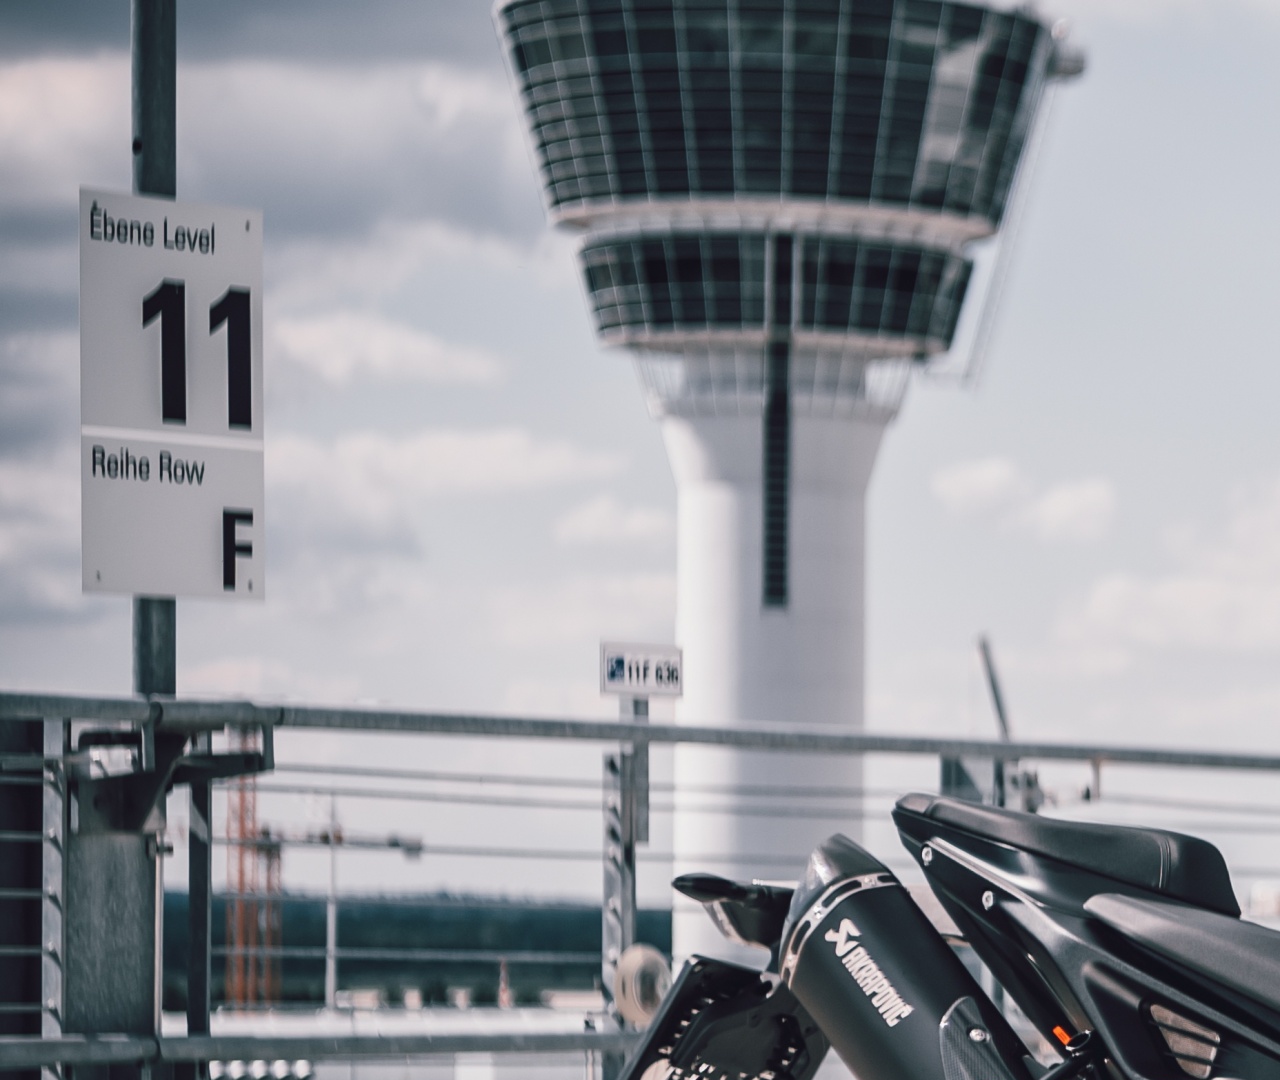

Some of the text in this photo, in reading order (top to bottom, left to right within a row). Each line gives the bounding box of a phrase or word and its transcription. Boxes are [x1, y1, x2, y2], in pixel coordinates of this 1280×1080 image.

[163, 216, 215, 256] Level
[142, 277, 252, 431] 11
[92, 444, 205, 487] Reihe Row
[222, 507, 254, 591] F
